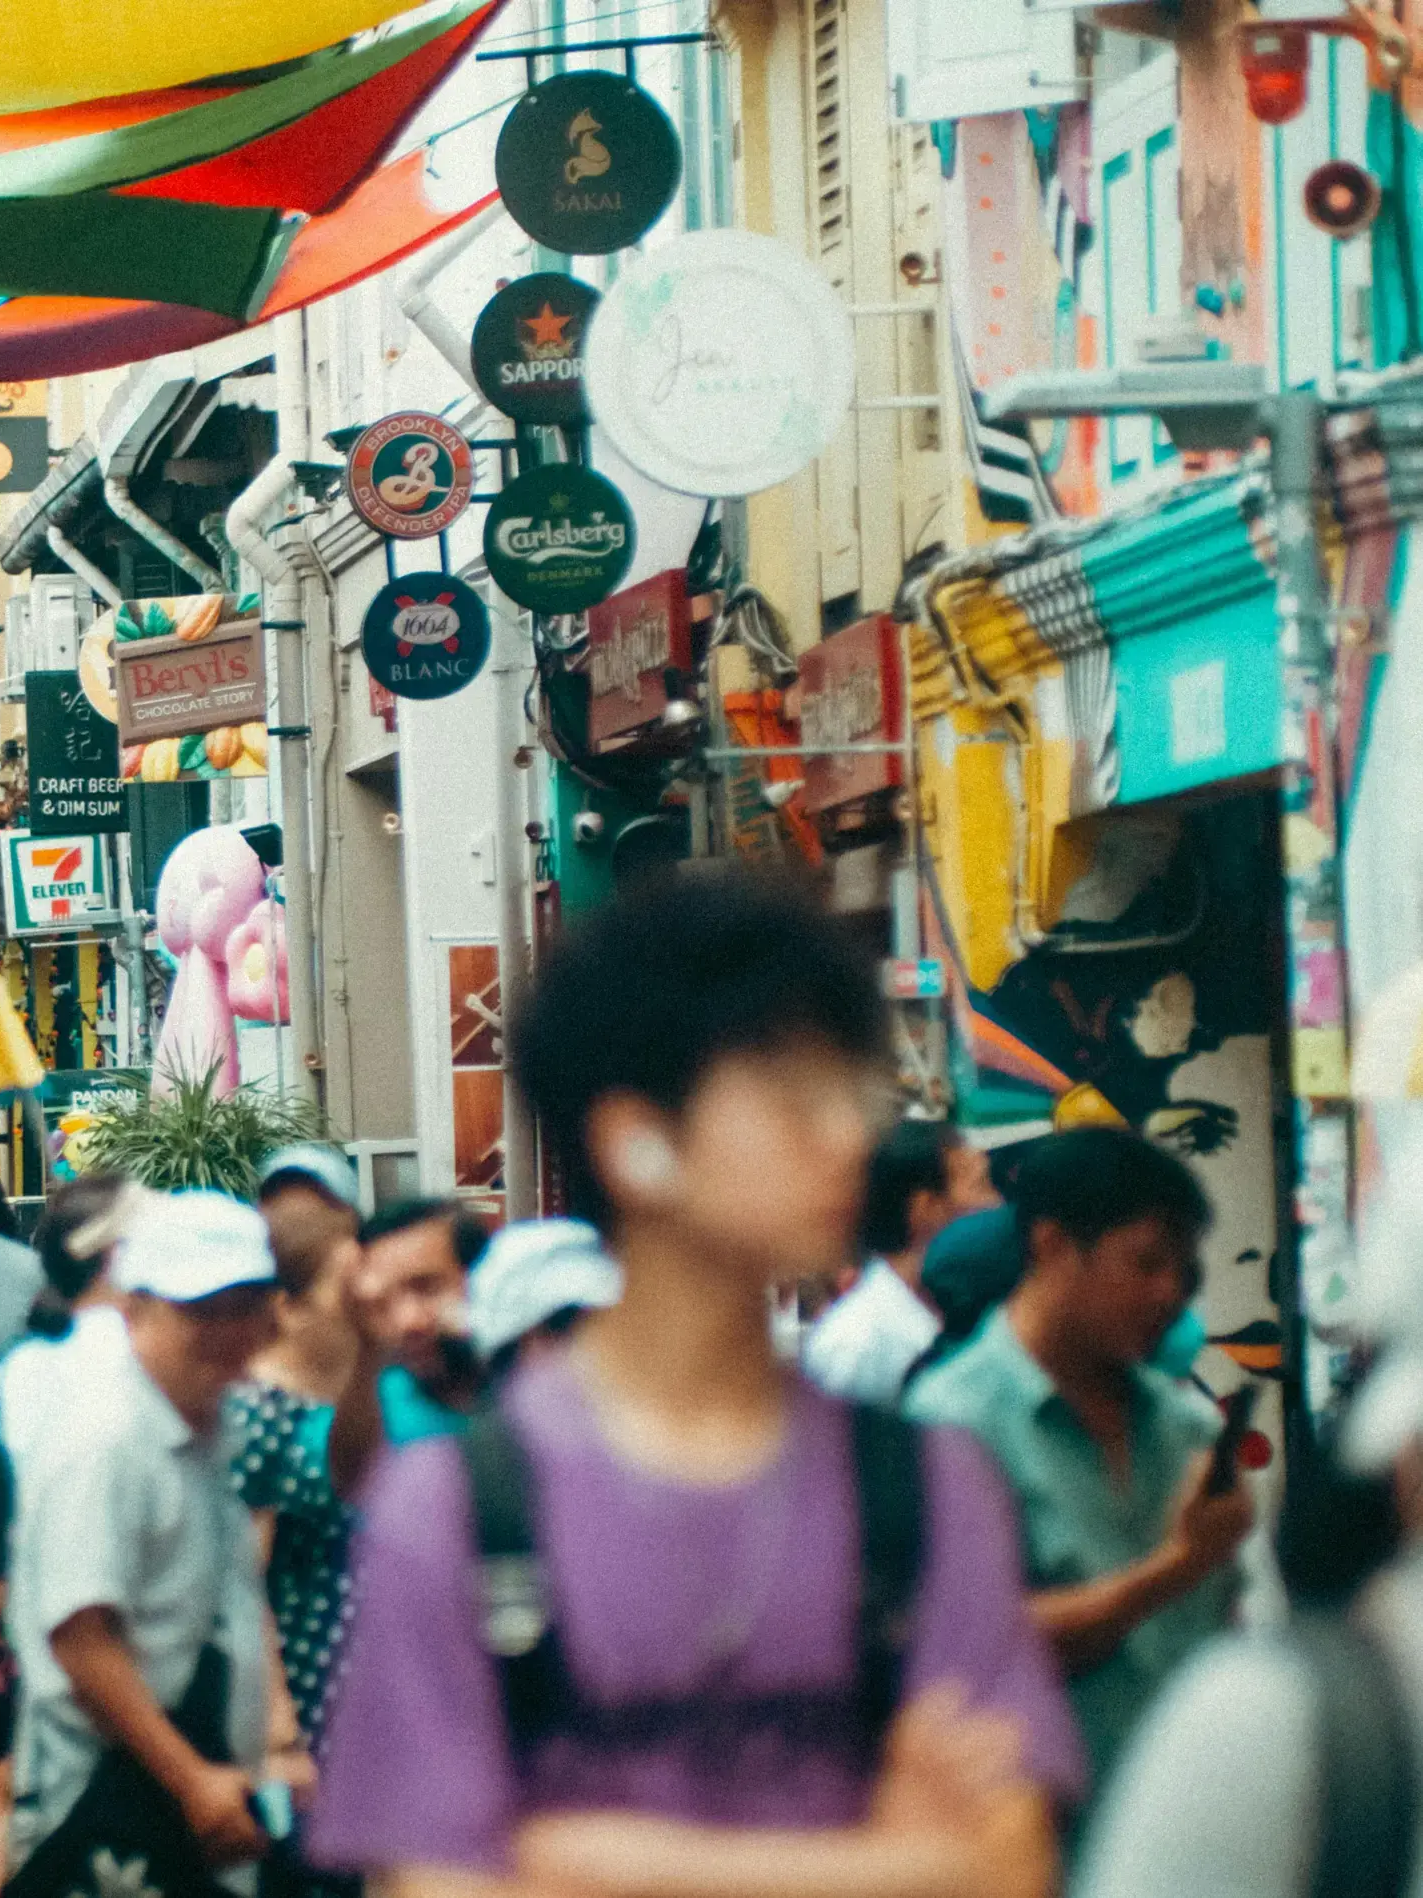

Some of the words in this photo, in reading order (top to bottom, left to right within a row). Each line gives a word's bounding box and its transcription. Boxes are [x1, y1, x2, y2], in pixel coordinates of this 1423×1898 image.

[365, 418, 461, 451] BROOKLYN
[359, 486, 445, 531] DEFENDER
[496, 515, 625, 558] Carlsberg
[403, 613, 450, 637] 1664
[131, 647, 250, 699] Beryl's
[390, 658, 470, 682] BLANC
[136, 698, 211, 720] CHOCOLATE
[214, 689, 255, 706] STORY
[38, 777, 84, 794] CRAFT
[88, 777, 124, 793] BEER
[42, 800, 55, 814] &
[57, 800, 86, 815] DIM
[89, 800, 121, 815] SUM
